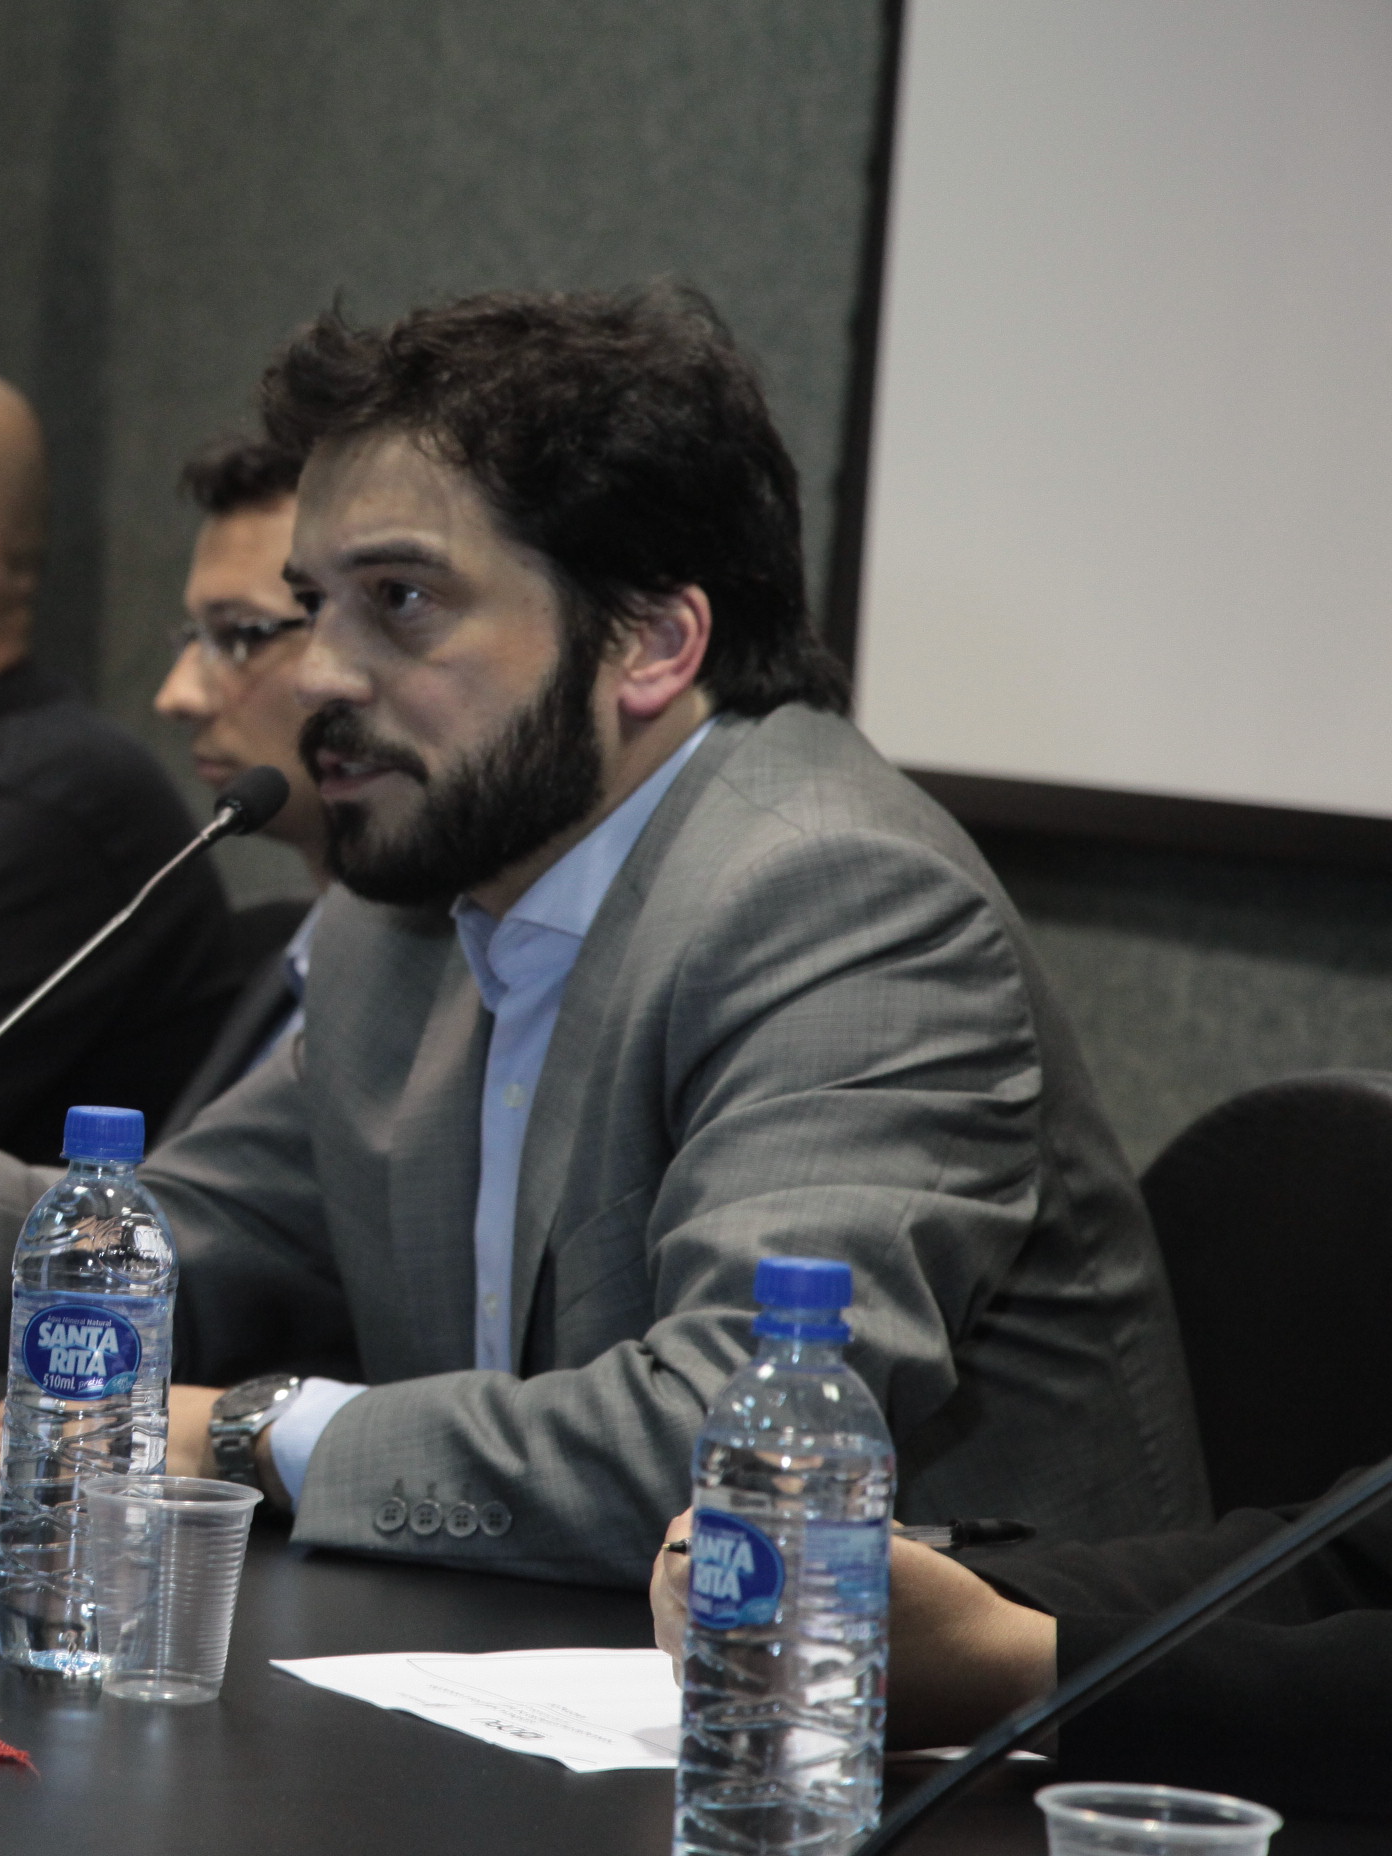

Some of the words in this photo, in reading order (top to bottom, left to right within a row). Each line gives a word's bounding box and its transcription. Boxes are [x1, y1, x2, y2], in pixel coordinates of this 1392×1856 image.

[37, 1321, 119, 1354] SANTA
[87, 1319, 112, 1327] Natural
[48, 1347, 107, 1376] RITA
